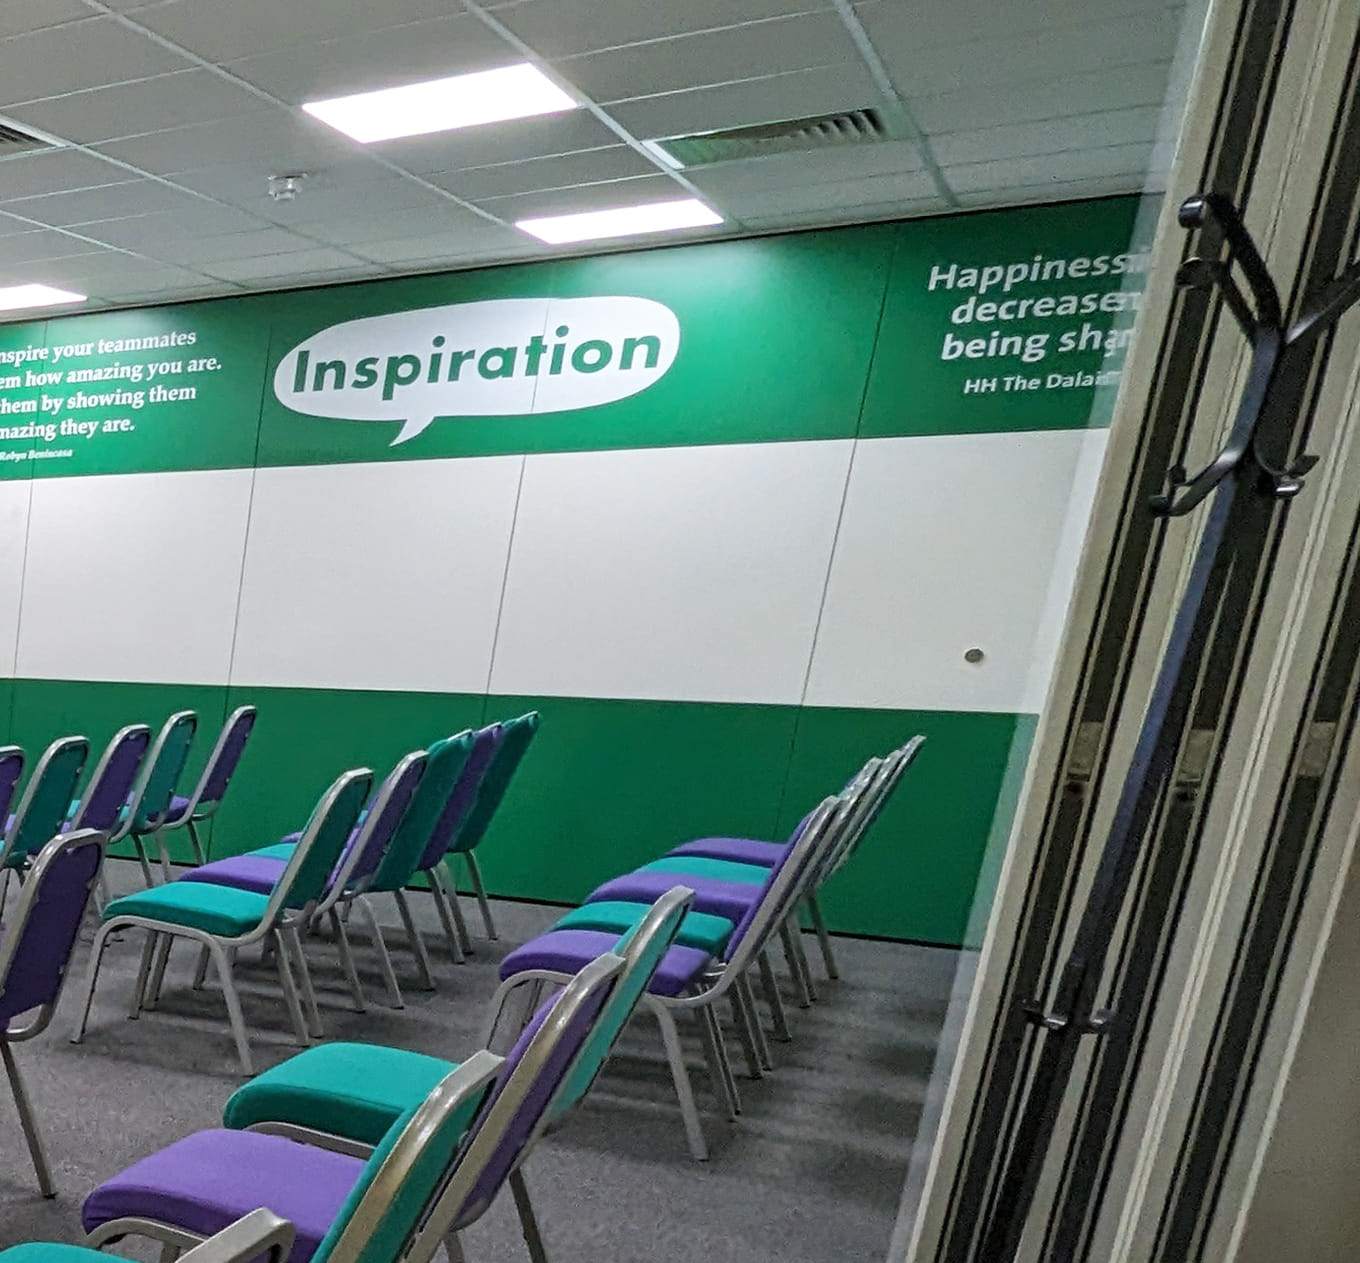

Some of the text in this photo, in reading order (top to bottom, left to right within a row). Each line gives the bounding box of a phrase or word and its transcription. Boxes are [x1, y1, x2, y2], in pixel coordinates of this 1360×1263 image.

[928, 254, 1130, 294] Happiness
[52, 341, 94, 364] your
[97, 332, 197, 354] teammates
[941, 331, 1050, 363] being
[25, 370, 63, 387] how
[66, 362, 144, 382] amazing
[146, 360, 182, 381] you
[187, 357, 222, 373] are.
[292, 325, 662, 401] Inspiration
[41, 395, 63, 415] by
[67, 389, 145, 409] showing
[149, 385, 196, 403] them
[963, 378, 997, 394] HH
[1003, 375, 1040, 392] The
[60, 418, 99, 439] they
[102, 418, 135, 433] are.
